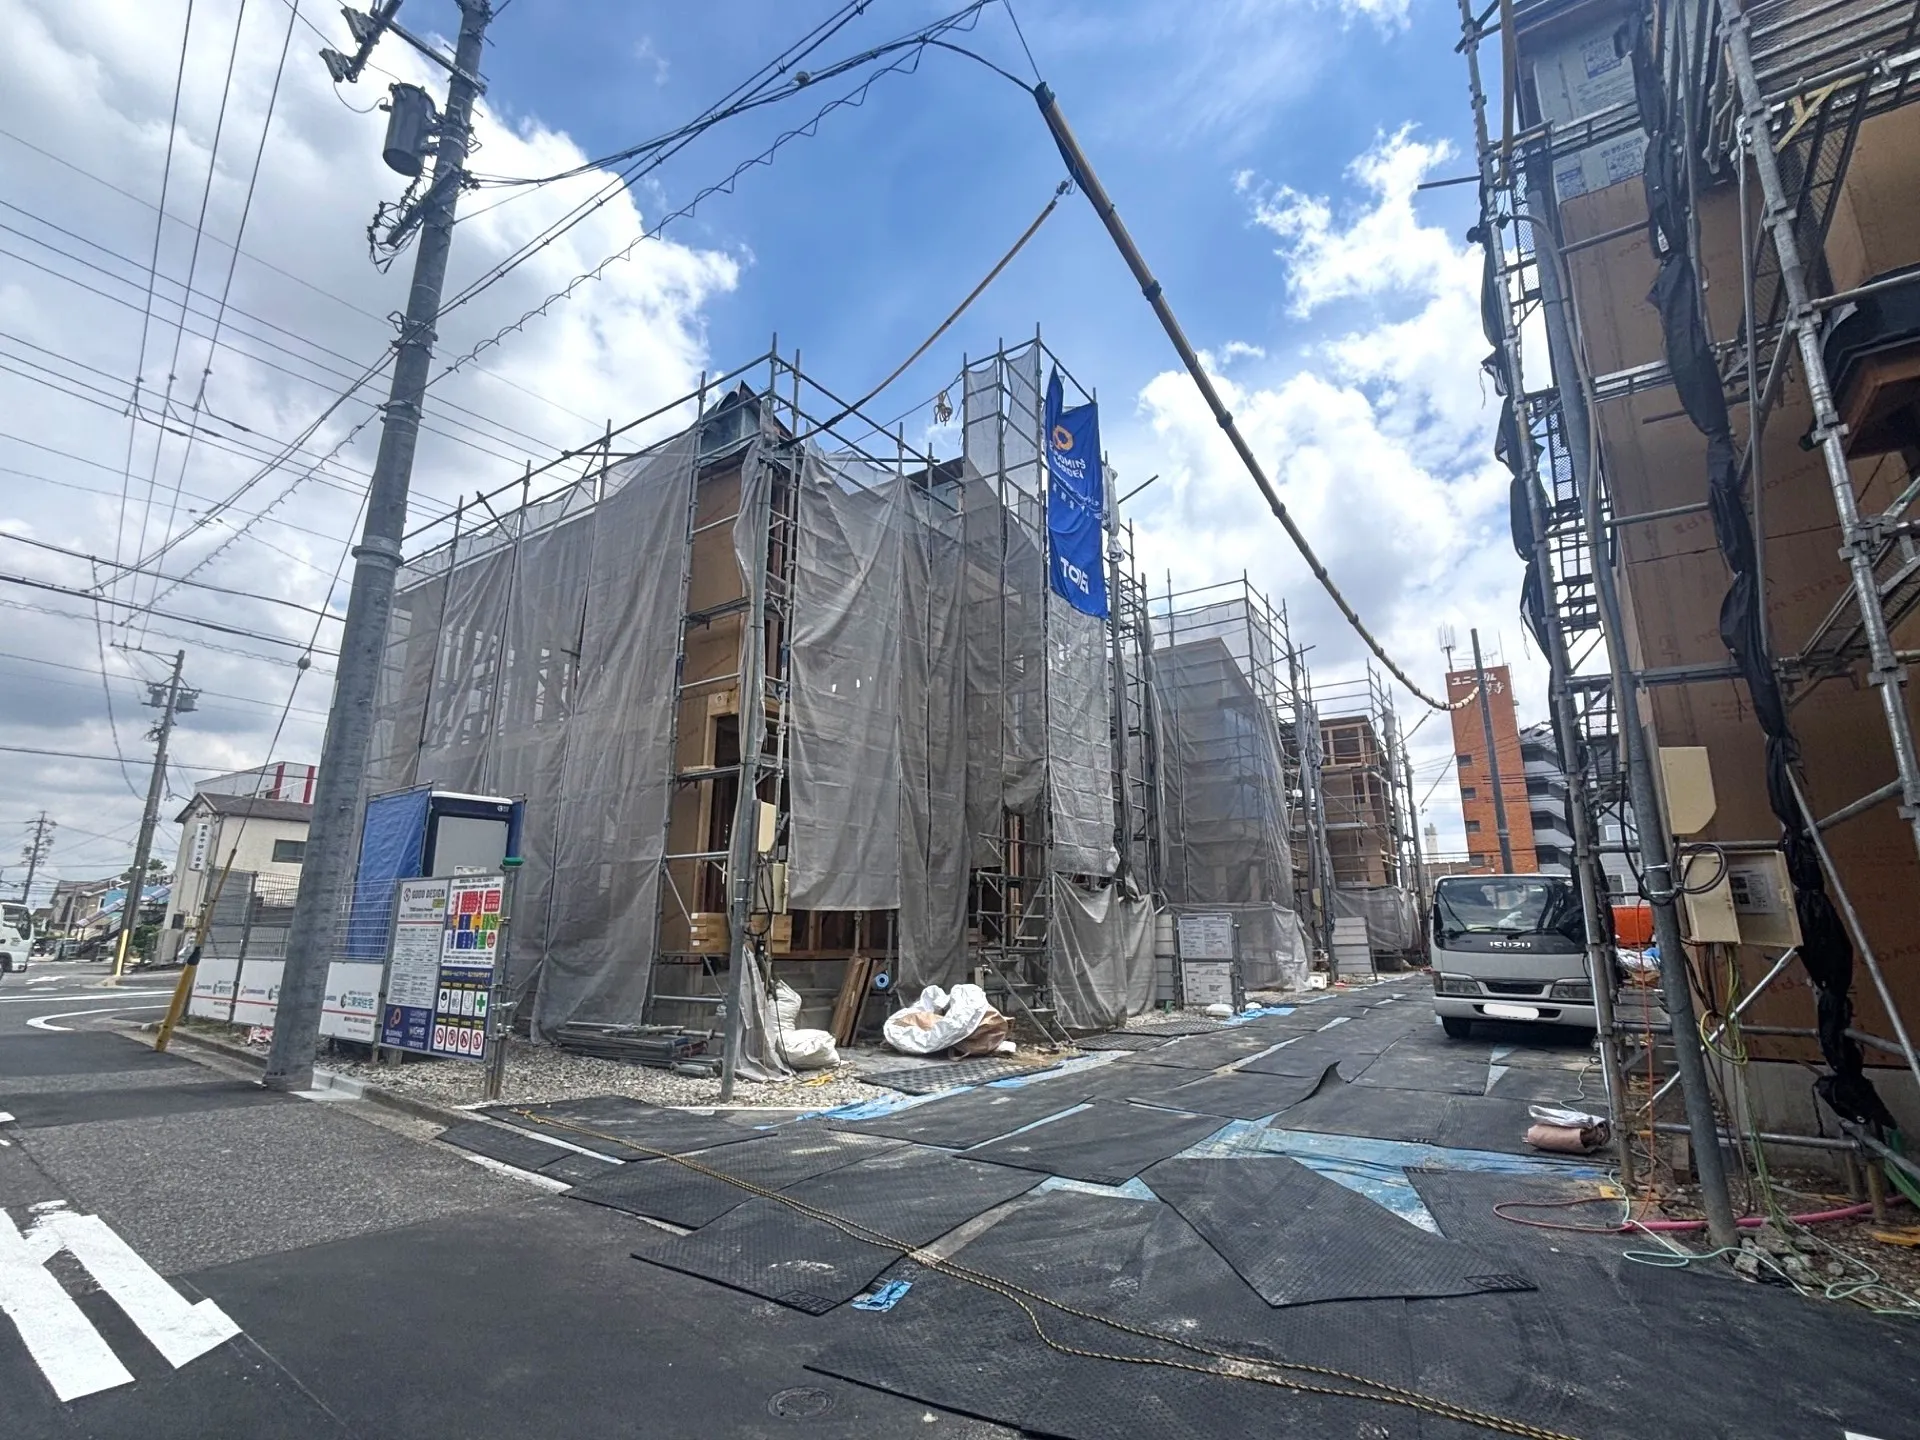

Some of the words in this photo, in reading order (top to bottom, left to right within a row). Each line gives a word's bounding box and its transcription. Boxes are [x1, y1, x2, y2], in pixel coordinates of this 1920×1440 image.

[412, 889, 425, 899] GOOD
[426, 888, 445, 899] DESIGN
[1489, 941, 1531, 949] ISUZU
